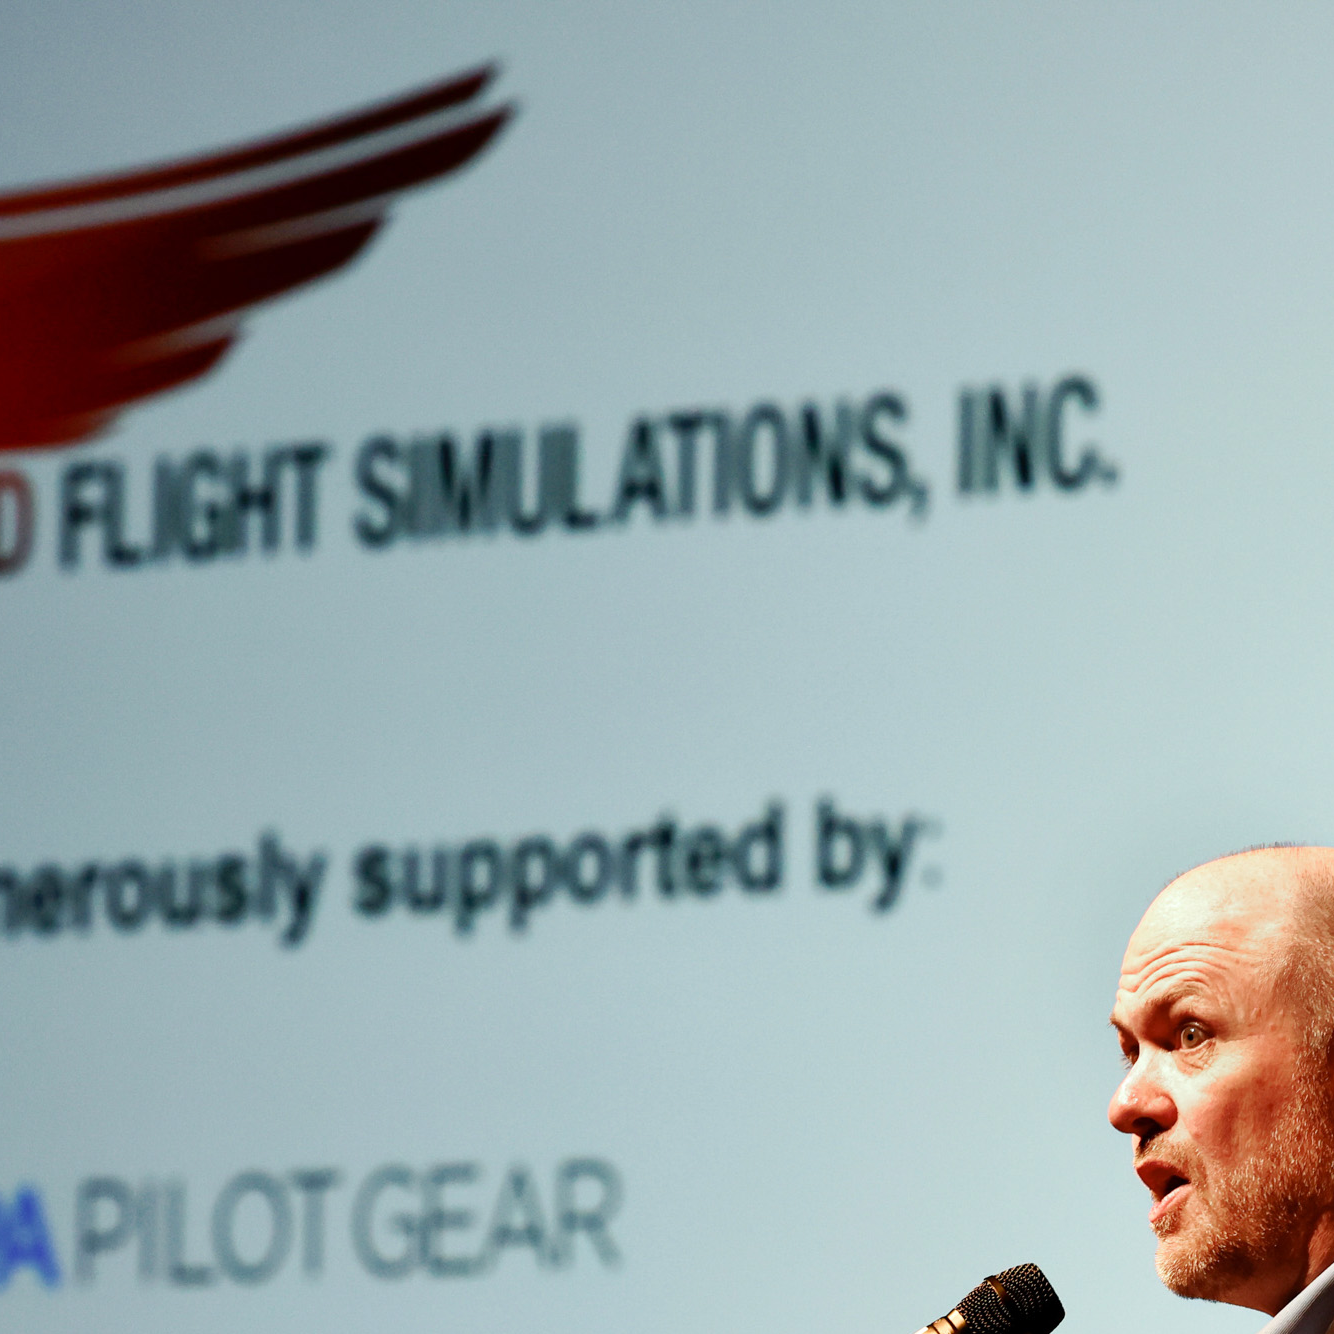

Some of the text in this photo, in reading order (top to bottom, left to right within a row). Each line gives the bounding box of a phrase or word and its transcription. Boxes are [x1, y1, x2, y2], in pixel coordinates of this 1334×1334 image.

[59, 445, 327, 570] FLIGHT
[356, 395, 931, 548] SIMULATIONS,
[956, 378, 1119, 494] INC.
[352, 803, 784, 942] supported
[815, 798, 943, 910] by:
[75, 1168, 339, 1287] PILOT
[350, 1156, 623, 1282] GEAR
